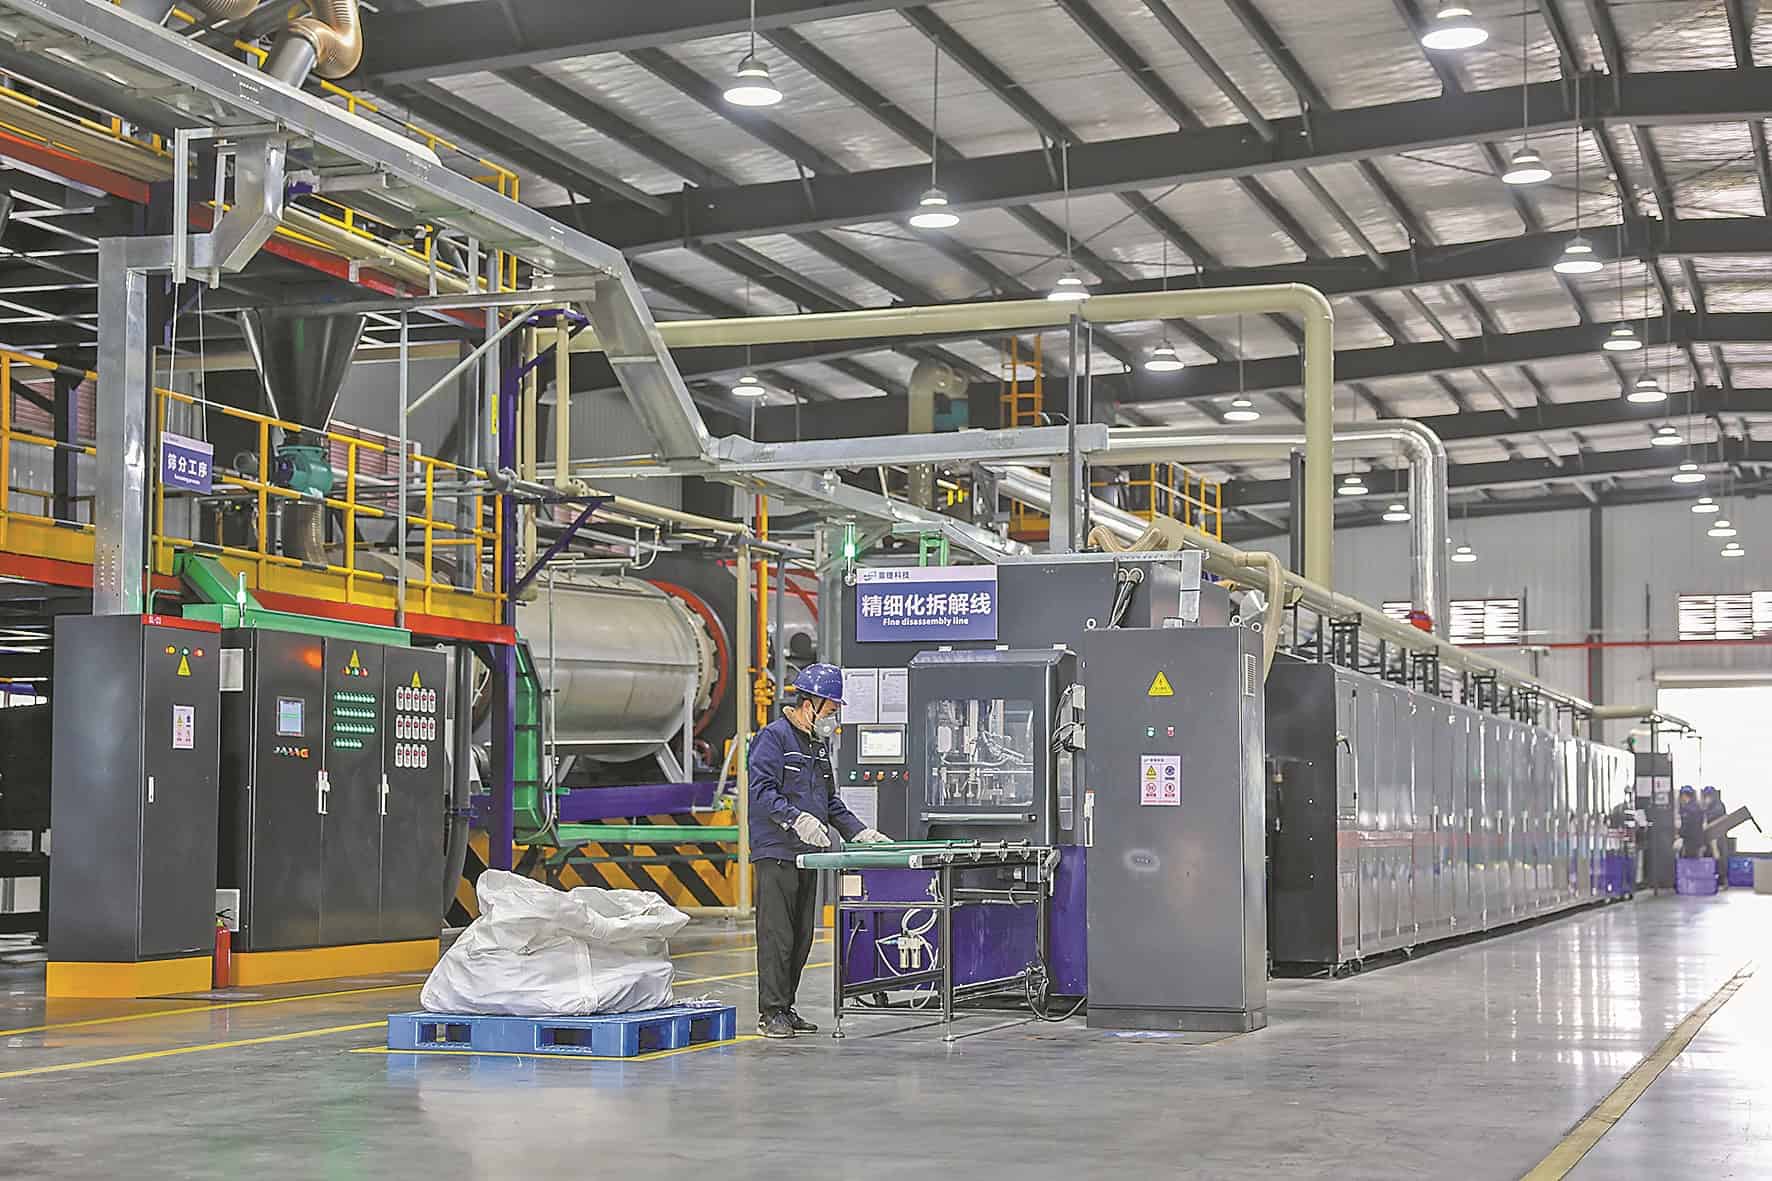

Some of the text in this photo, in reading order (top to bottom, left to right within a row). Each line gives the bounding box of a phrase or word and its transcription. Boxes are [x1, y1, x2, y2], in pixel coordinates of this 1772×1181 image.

[167, 452, 208, 478] 筛分工序
[861, 592, 992, 617] 精细化拆解线
[882, 616, 969, 627] Fine disassembly line
